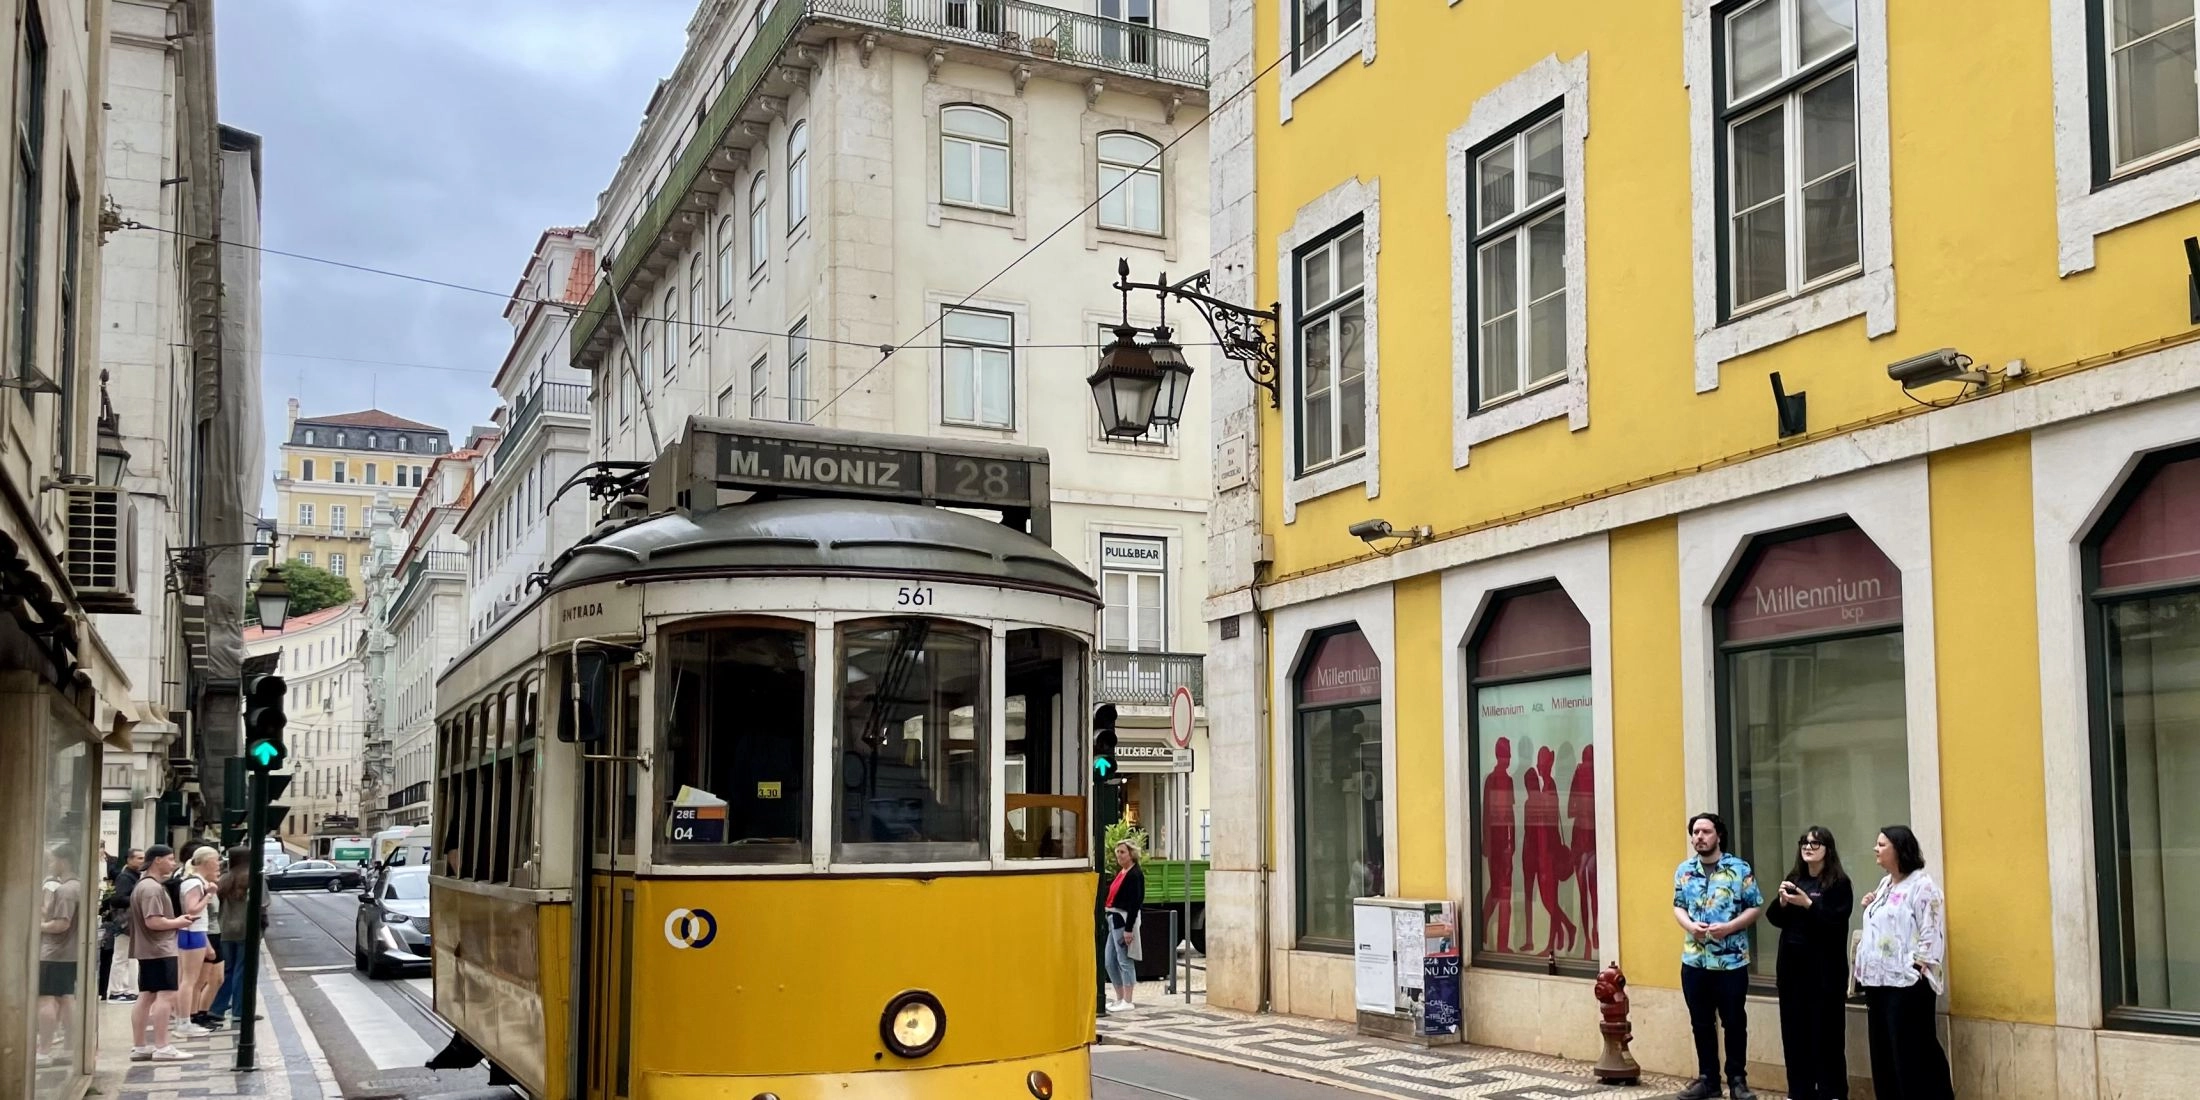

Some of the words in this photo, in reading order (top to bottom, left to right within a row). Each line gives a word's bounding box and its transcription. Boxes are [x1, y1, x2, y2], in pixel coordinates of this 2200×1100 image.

[730, 450, 769, 477] M.
[783, 455, 900, 487] MONIZ
[954, 459, 1010, 497] 28
[1105, 546, 1159, 560] PULL&BEAR
[897, 587, 933, 606] 561
[1755, 578, 1881, 616] Millennium
[562, 602, 603, 623] ENTRADA
[1841, 605, 1864, 624] bcp
[1317, 665, 1380, 688] Millennium
[1481, 704, 1525, 718] Millennium
[1115, 746, 1165, 757] ULL&BEAR
[758, 788, 778, 798] 3.30
[676, 809, 696, 820] 28E
[674, 827, 693, 840] 04
